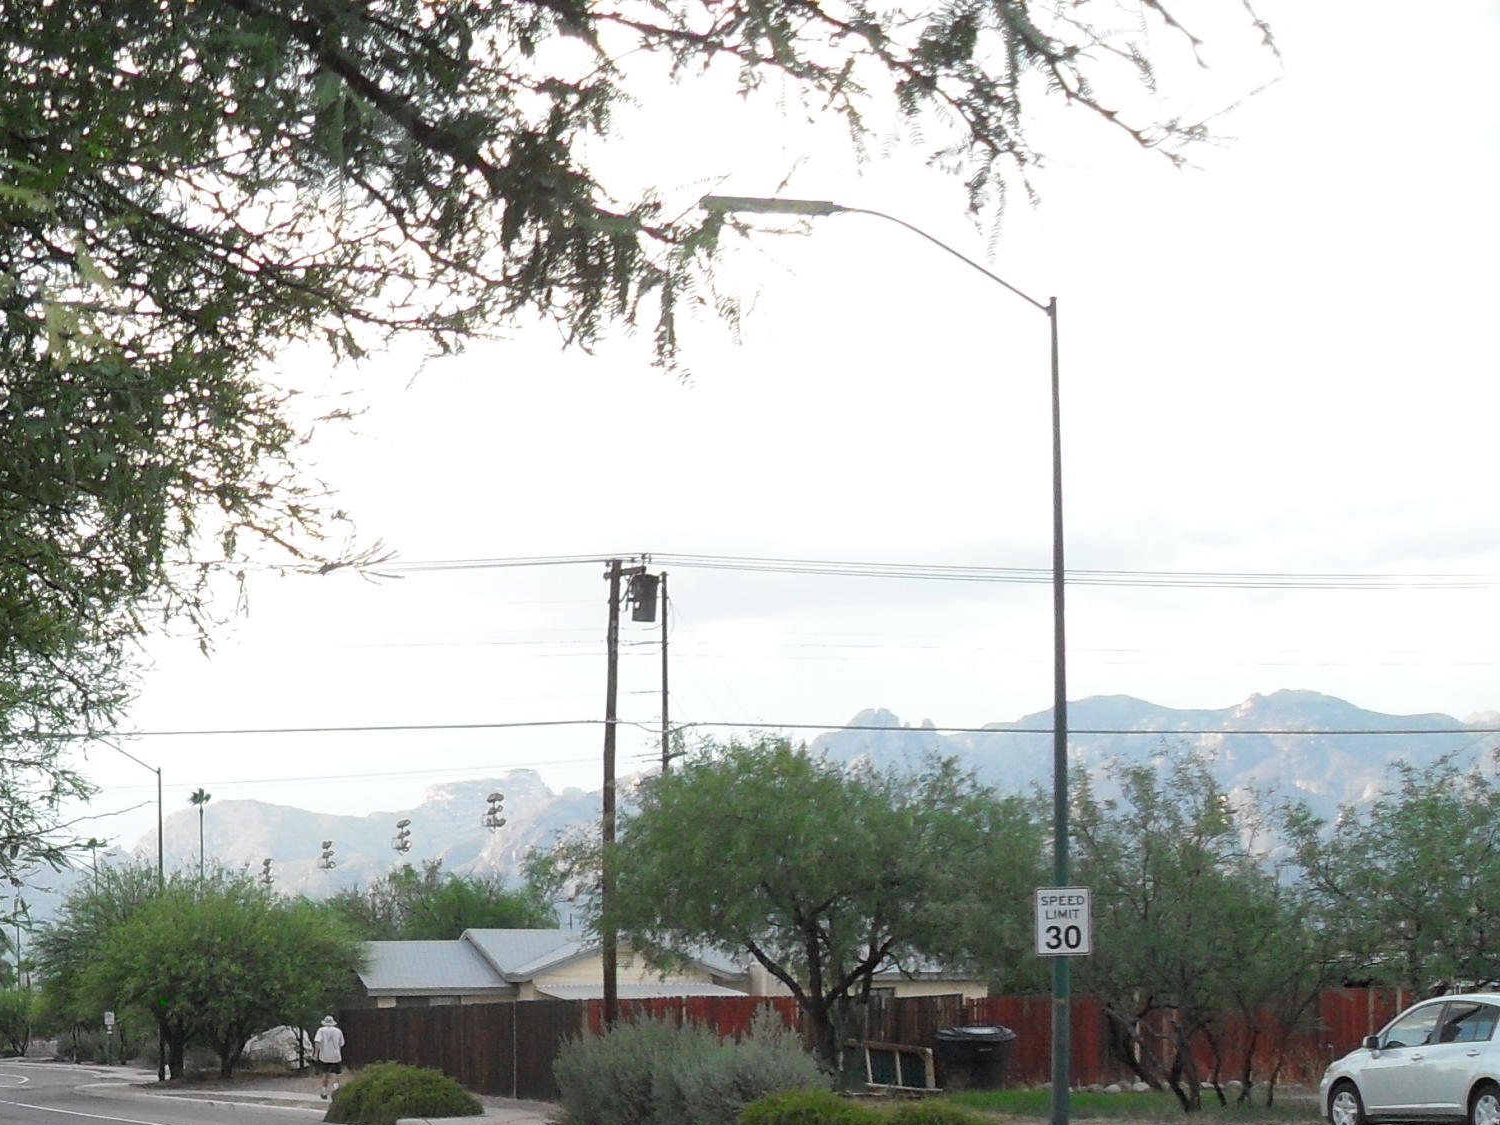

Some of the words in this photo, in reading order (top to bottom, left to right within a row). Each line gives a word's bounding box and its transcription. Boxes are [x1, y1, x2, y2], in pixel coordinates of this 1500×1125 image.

[1041, 895, 1085, 906] SPEED
[1045, 909, 1080, 920] LIMIT
[1045, 925, 1082, 949] 30
